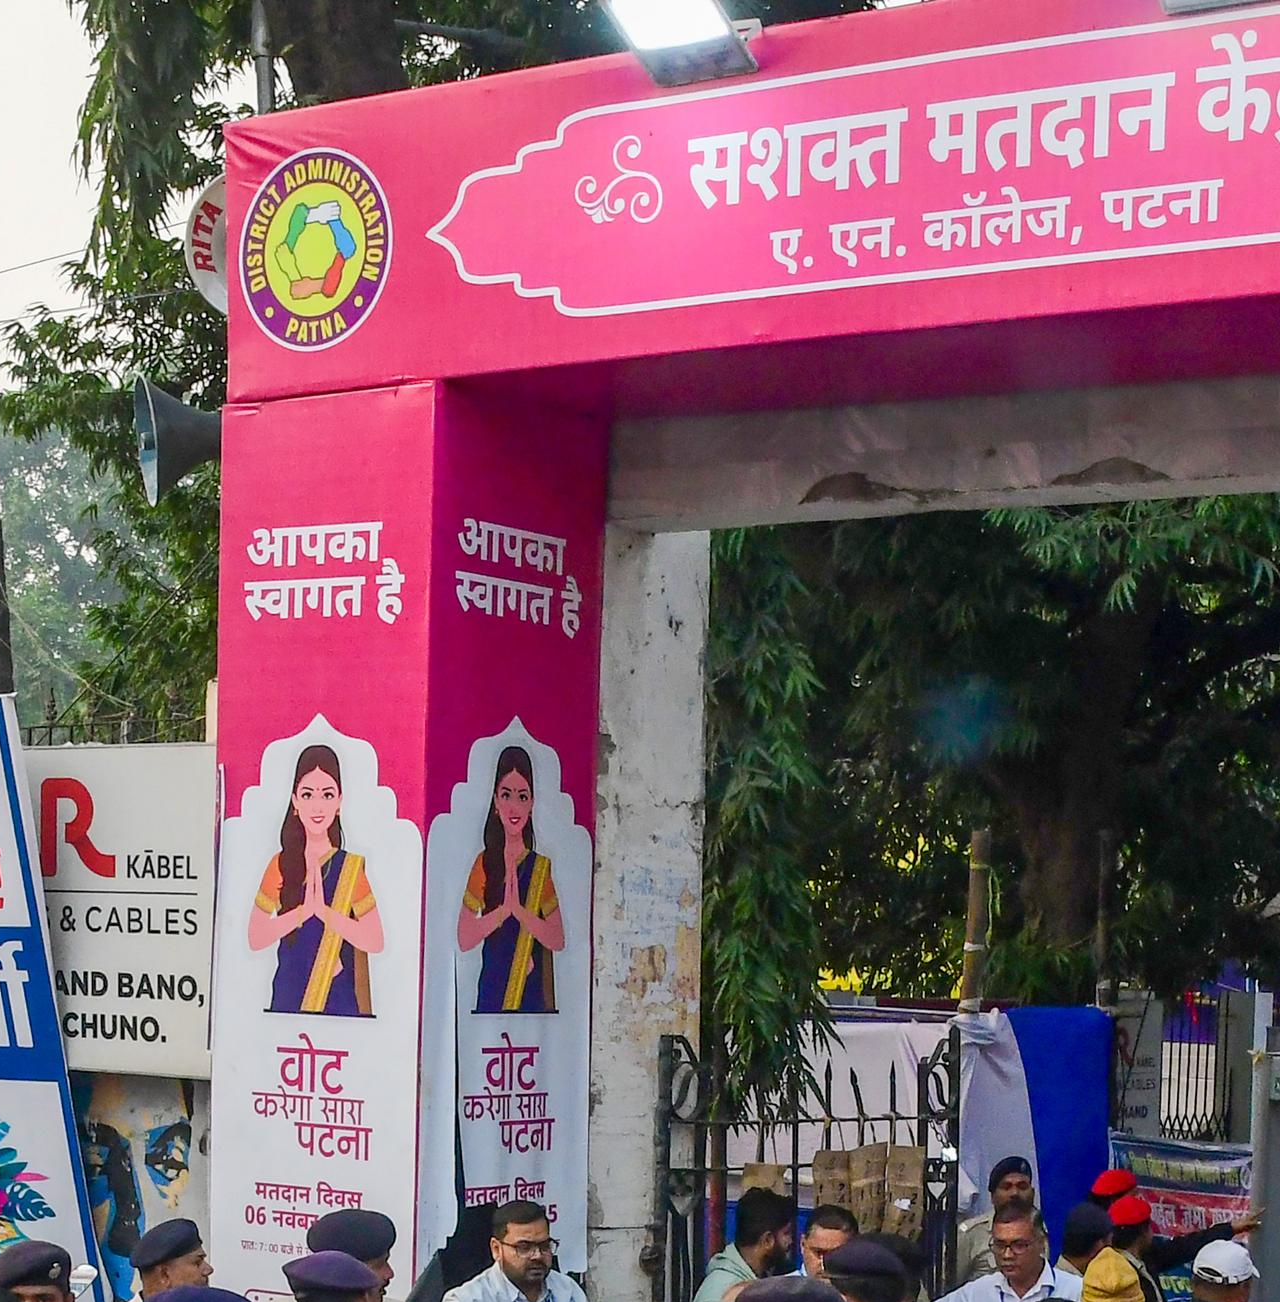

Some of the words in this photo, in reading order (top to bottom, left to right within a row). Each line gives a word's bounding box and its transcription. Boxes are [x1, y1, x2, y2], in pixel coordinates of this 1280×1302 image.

[687, 107, 909, 210] सशक्त
[926, 71, 1176, 175] मतदान
[191, 200, 224, 274] RITA
[246, 185, 285, 294] DISTRICT
[283, 158, 385, 283] ADMINISTRATION
[770, 227, 815, 275] ए.
[829, 216, 908, 269] एन.
[922, 186, 1084, 253] कॉलेज,
[1100, 178, 1225, 233] पटना
[284, 311, 348, 344] PATNA
[246, 521, 383, 568] आपका
[457, 517, 567, 576] आपका
[243, 576, 367, 622] स्वागत
[375, 556, 406, 625] है
[455, 570, 554, 626] स्वागत
[561, 575, 583, 640] है
[126, 850, 198, 880] KĀBEL
[60, 906, 77, 933] &
[86, 906, 199, 935] CABLES
[117, 973, 205, 1008] BANO,
[63, 1011, 167, 1043] CHUNO.
[276, 1033, 349, 1095] वोट
[481, 1032, 539, 1092] वोट
[252, 1085, 313, 1123] करेगा
[319, 1096, 364, 1126] सारा
[463, 1086, 511, 1121] करेगा
[517, 1092, 548, 1119] सारा
[294, 1121, 373, 1161] पटना
[499, 1118, 555, 1154] पटना
[255, 1181, 311, 1205] मतदान
[316, 1181, 362, 1209] दिवस
[464, 1184, 510, 1204] मतदान
[515, 1177, 546, 1200] दिवस
[244, 1203, 267, 1227] 06
